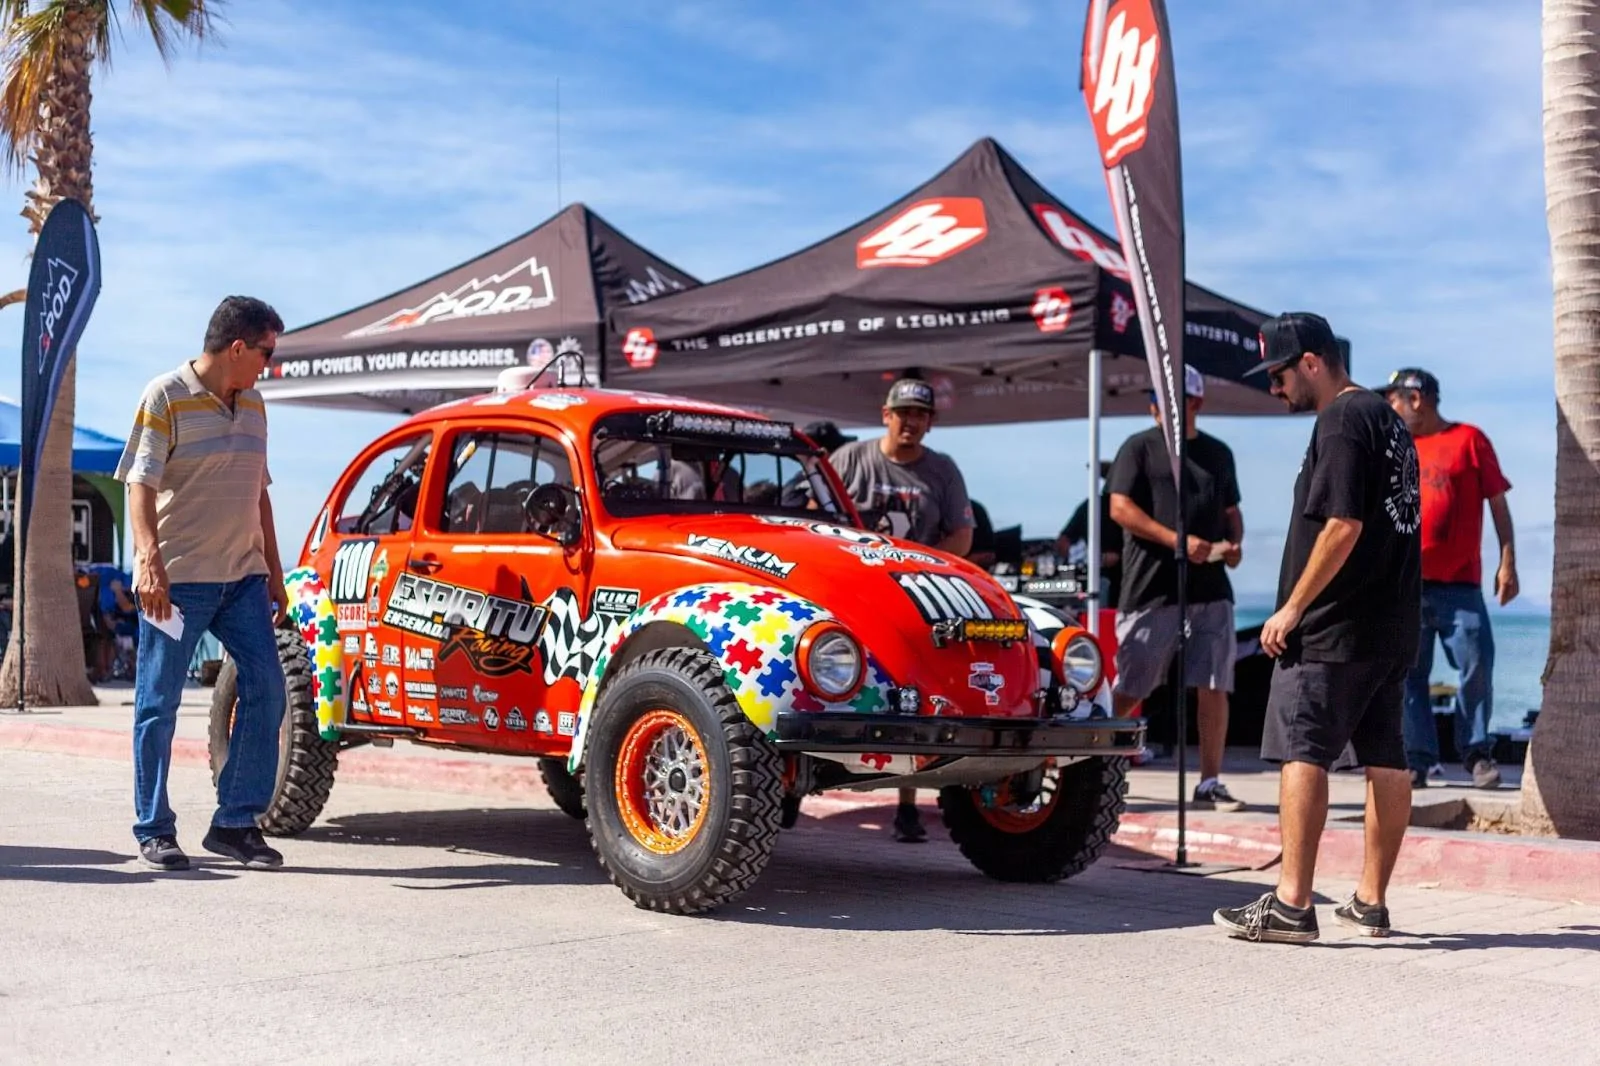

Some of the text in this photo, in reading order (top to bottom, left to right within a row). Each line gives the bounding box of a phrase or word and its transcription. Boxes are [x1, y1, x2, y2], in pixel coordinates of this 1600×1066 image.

[671, 308, 1010, 350] THE SCIENTISTS OF LIGHTING
[312, 354, 363, 376] POWER
[368, 351, 407, 371] YOUR
[410, 347, 519, 369] ACCESSORIES.
[331, 540, 376, 601] 1100
[687, 533, 797, 575] VENUM
[339, 605, 366, 621] SCORE
[388, 572, 546, 644] ESPIRITU
[598, 591, 638, 606] KING
[899, 573, 993, 619] 1100
[383, 609, 450, 640] ENSENADA
[448, 626, 530, 671] Racing
